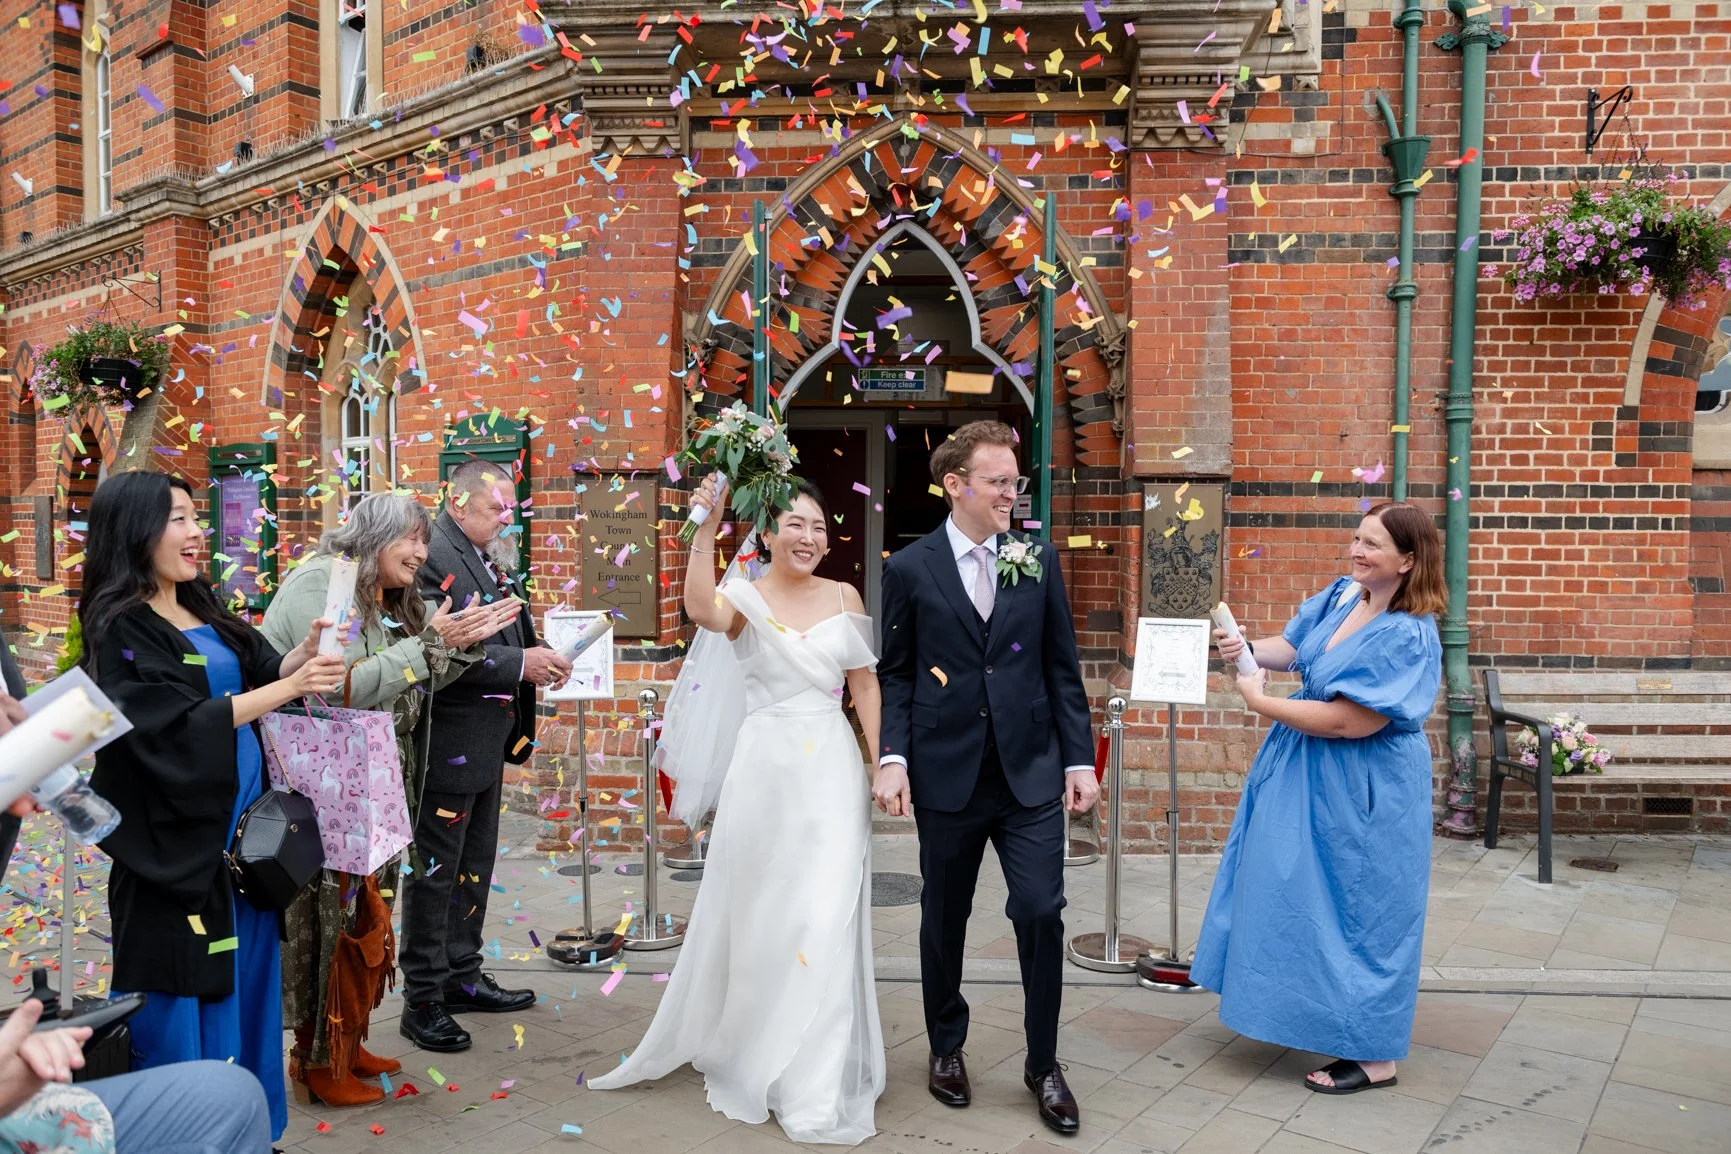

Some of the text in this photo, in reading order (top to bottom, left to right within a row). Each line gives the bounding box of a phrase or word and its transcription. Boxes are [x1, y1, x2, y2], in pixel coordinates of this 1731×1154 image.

[878, 381, 896, 389] Keep
[589, 509, 648, 521] Wokingham
[605, 525, 632, 535] Town
[600, 541, 637, 550] Counl
[607, 557, 631, 566] Mn
[598, 572, 640, 581] Entrance
